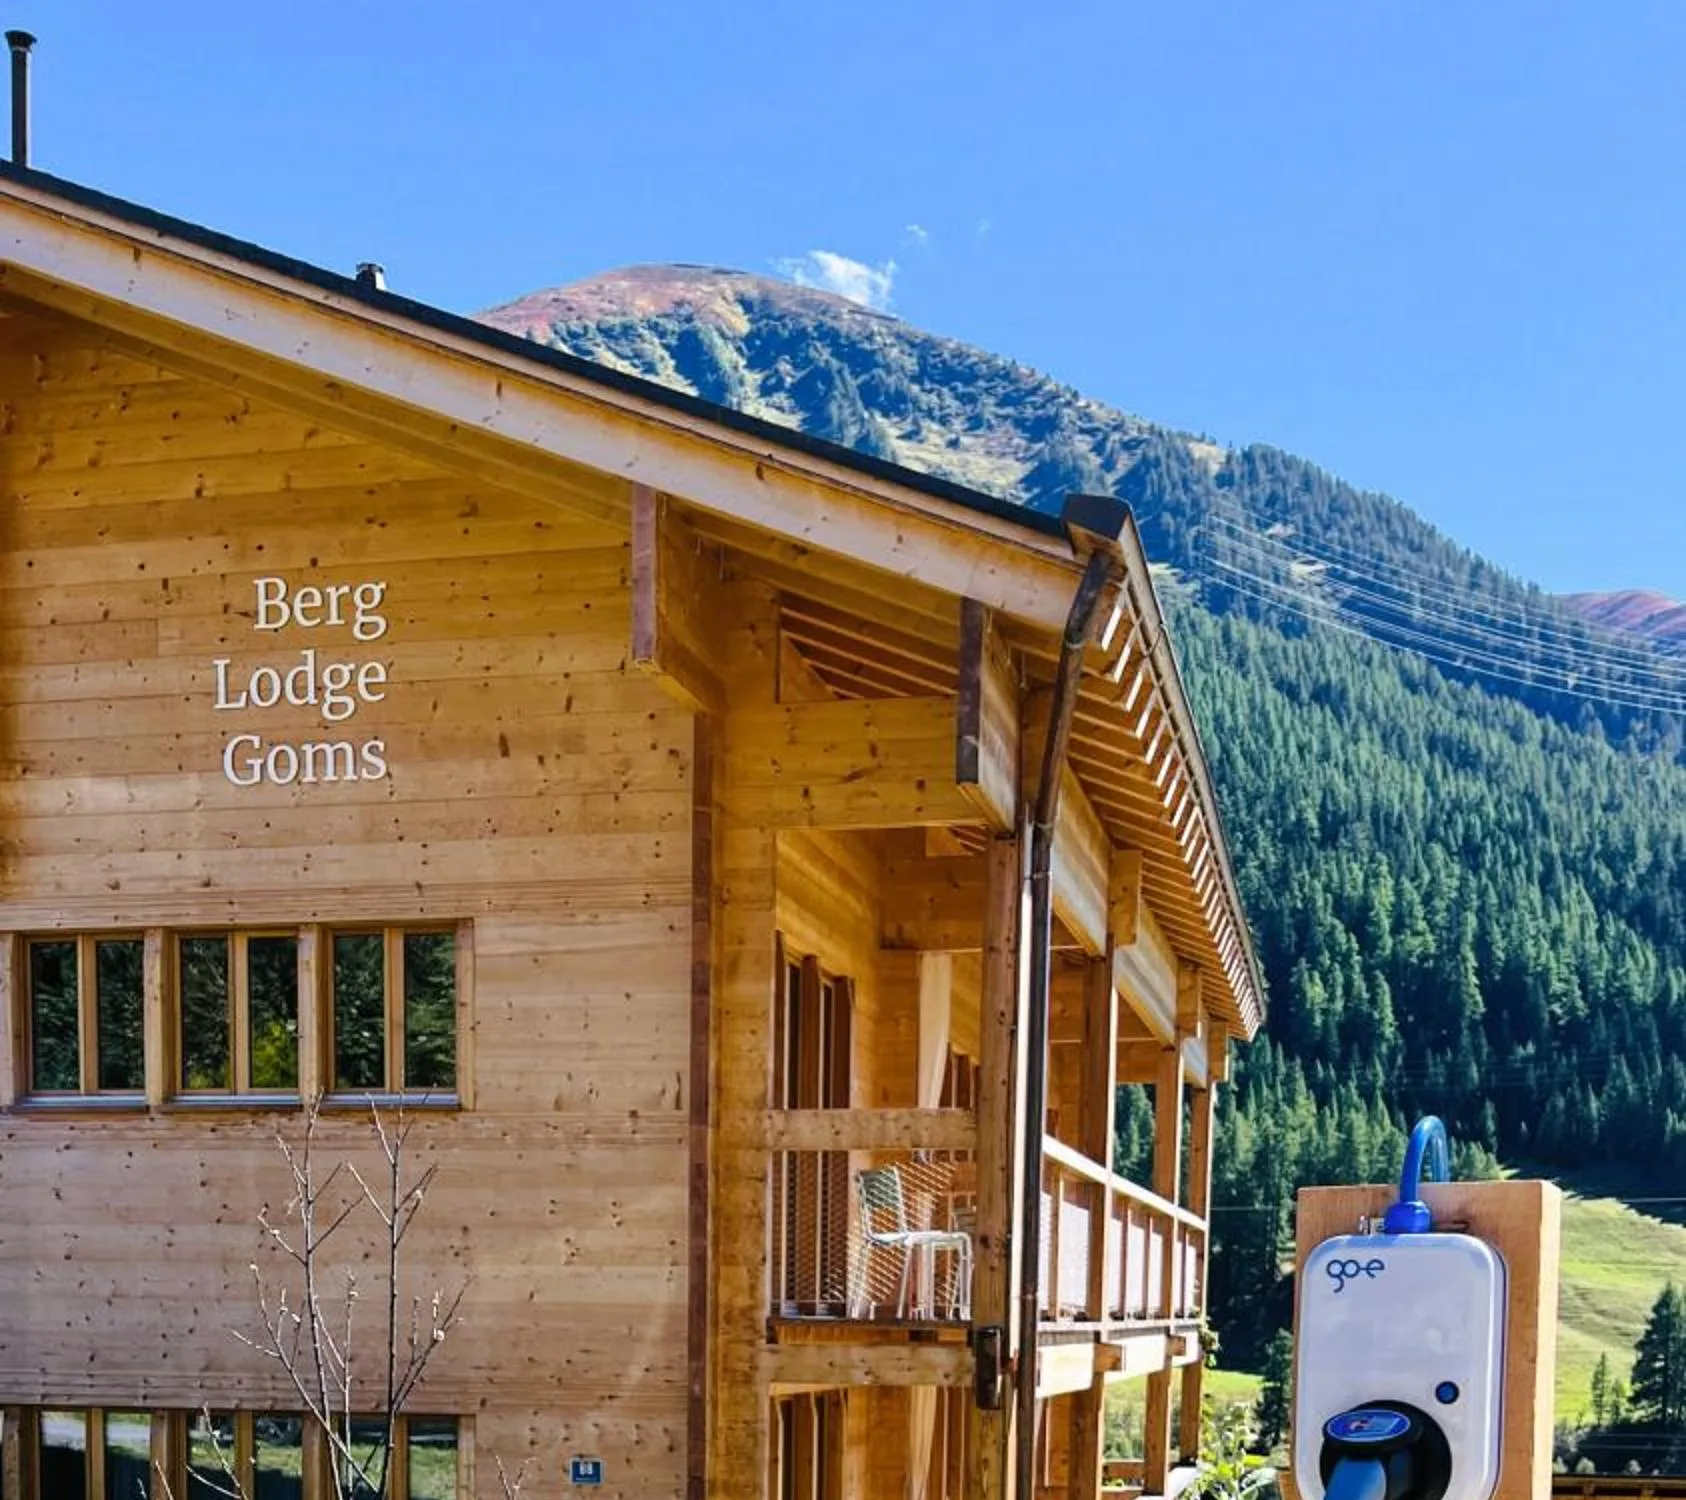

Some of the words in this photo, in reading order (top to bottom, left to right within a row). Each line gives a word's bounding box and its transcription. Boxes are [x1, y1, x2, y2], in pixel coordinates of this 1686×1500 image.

[253, 577, 387, 641] Berg
[212, 649, 387, 721] Lodge
[223, 734, 387, 786] Goms
